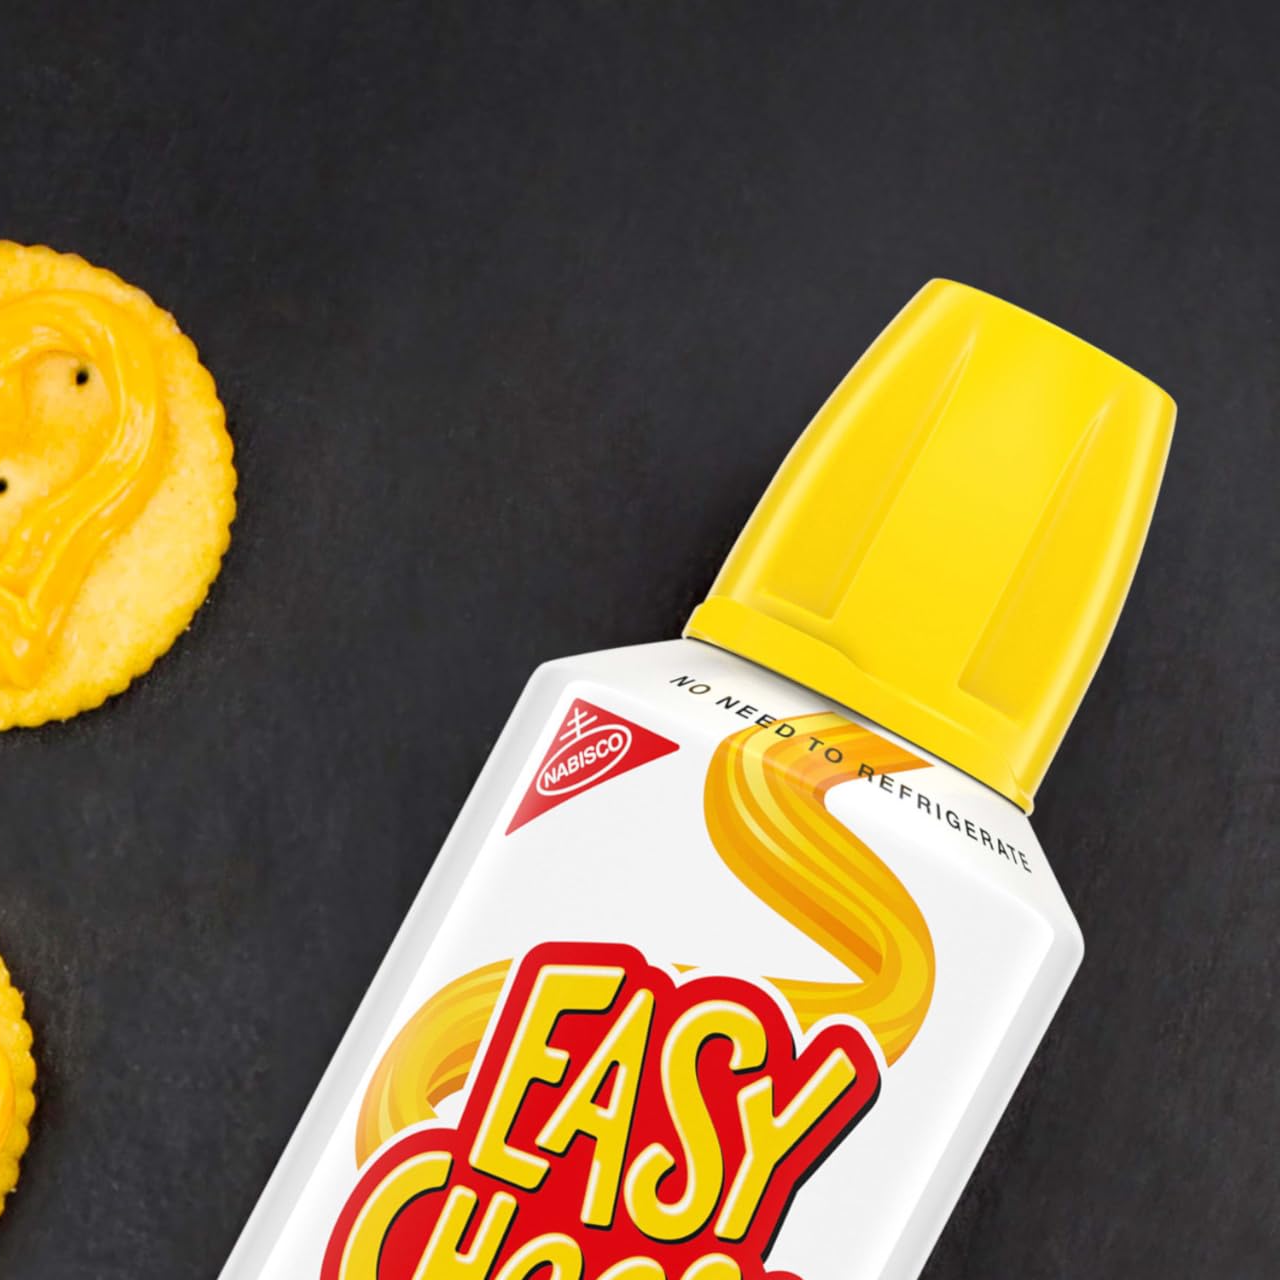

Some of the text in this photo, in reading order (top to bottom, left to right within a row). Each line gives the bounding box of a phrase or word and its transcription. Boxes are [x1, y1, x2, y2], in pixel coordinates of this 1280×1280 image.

[543, 731, 623, 788] NABISCO
[669, 675, 1033, 873] NO NEED TO REFRIGERATE
[469, 965, 857, 1240] EASY
